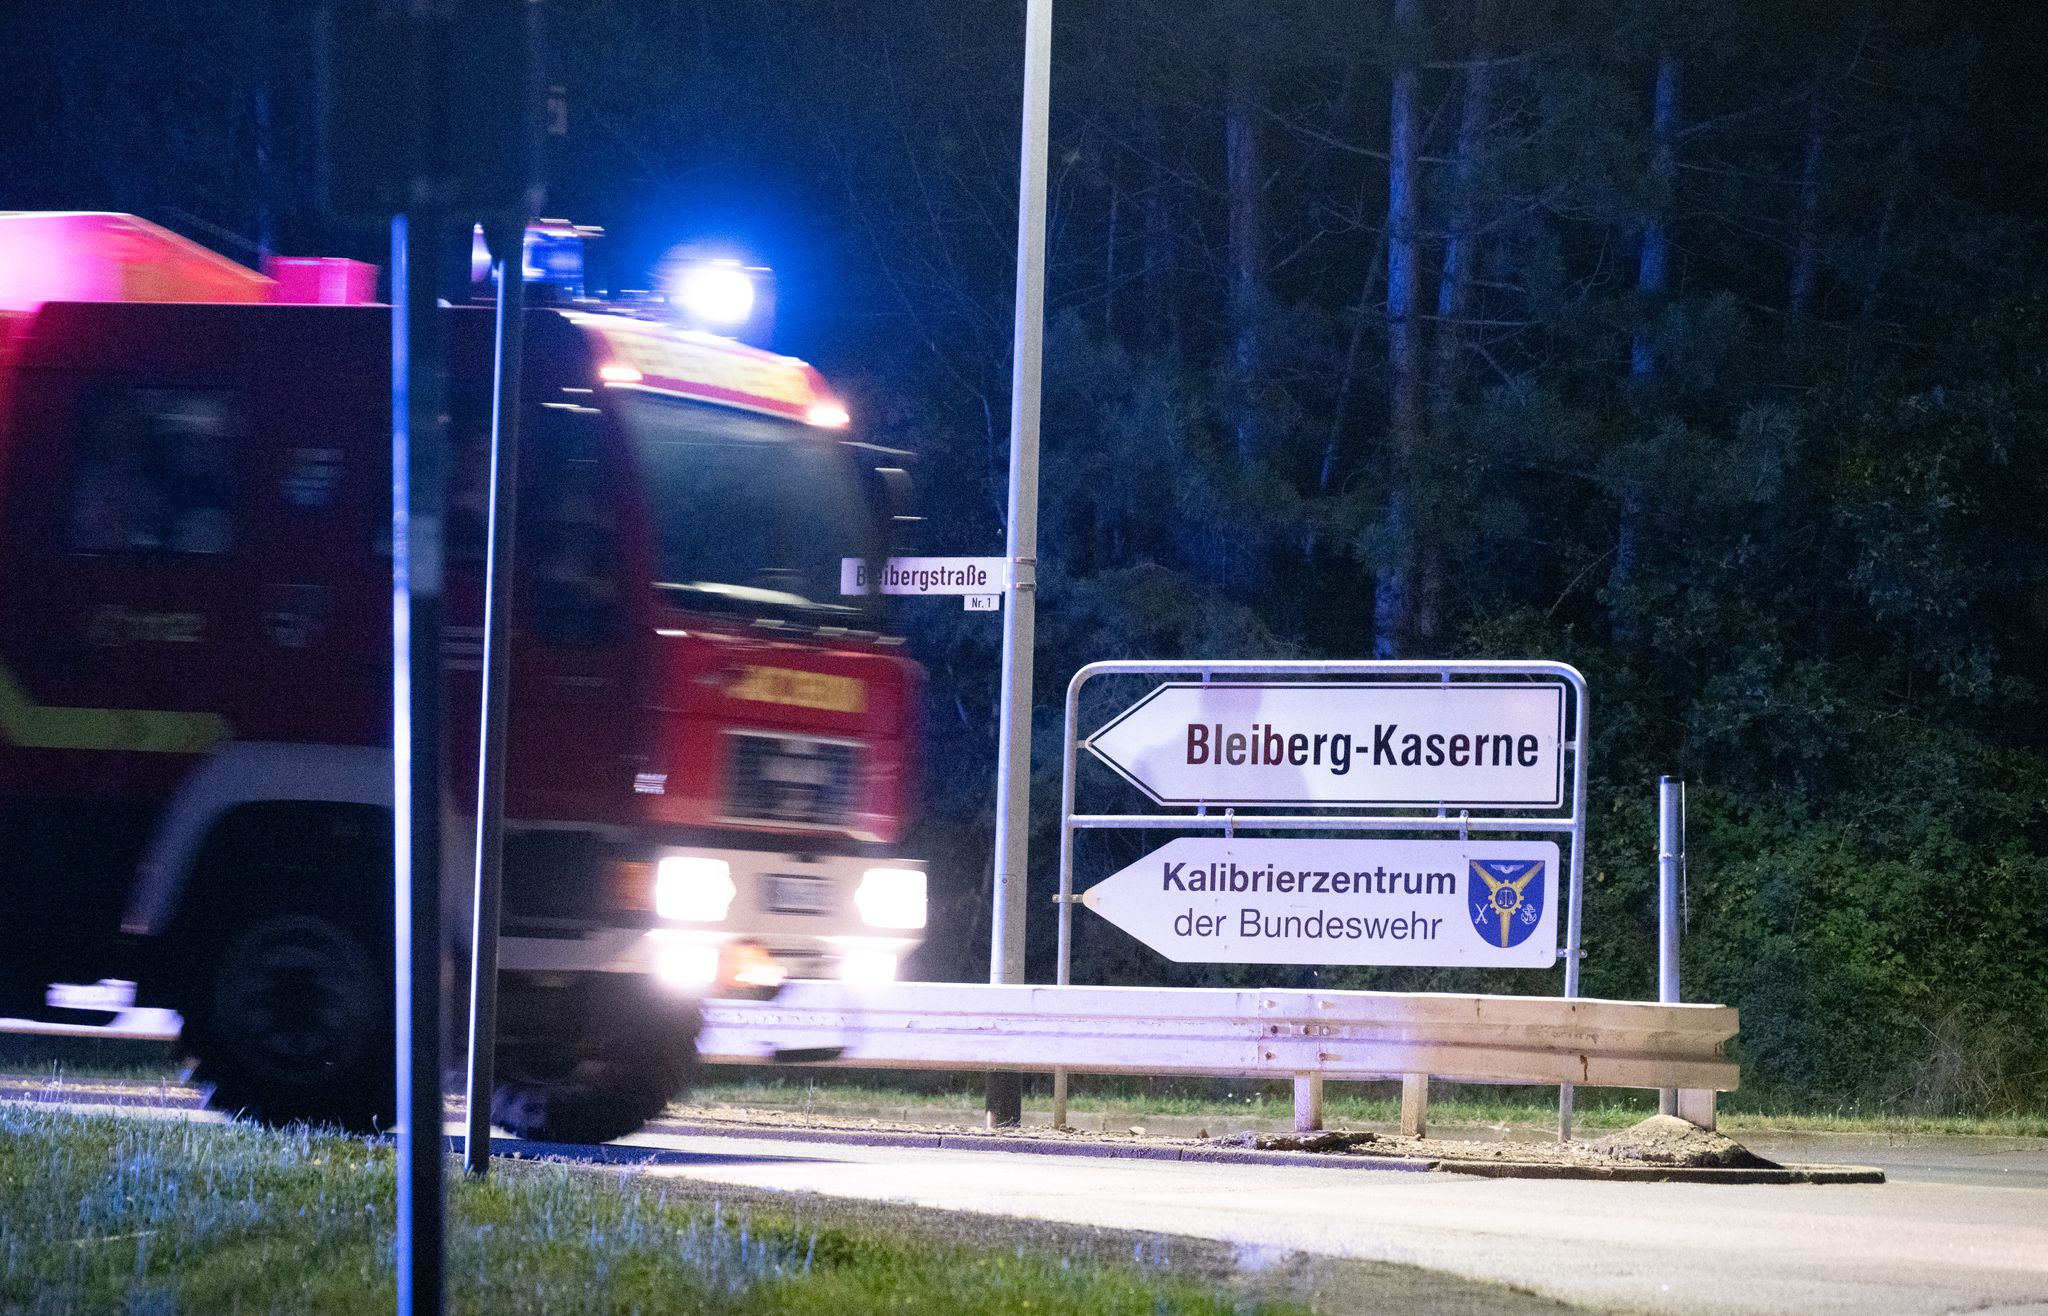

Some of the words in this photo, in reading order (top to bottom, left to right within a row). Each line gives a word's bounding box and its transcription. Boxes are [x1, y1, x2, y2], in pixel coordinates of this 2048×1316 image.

[856, 564, 987, 592] Beibergstraße
[972, 598, 984, 609] Nr.
[986, 597, 992, 609] 1
[1187, 724, 1539, 775] Bleiberg-Kaserne
[1163, 862, 1457, 895] Kalibrierzentrum
[1174, 907, 1228, 938] der
[1240, 908, 1444, 940] Bundeswehr
